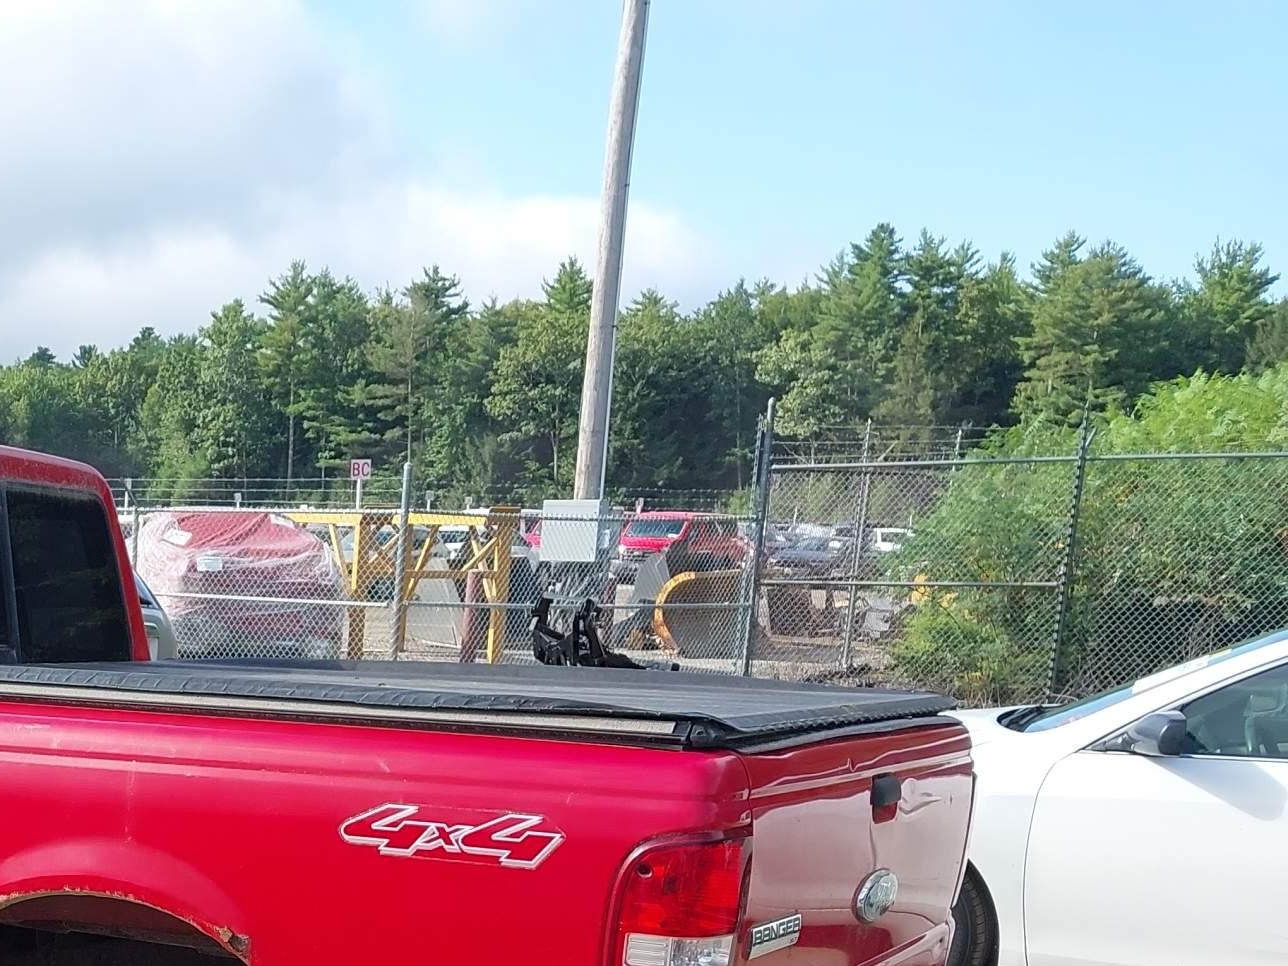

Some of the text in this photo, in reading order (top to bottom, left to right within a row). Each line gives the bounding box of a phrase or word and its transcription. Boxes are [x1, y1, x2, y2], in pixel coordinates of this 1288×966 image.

[353, 462, 369, 477] BC
[339, 802, 566, 870] 4x4
[753, 917, 802, 946] RANGER
